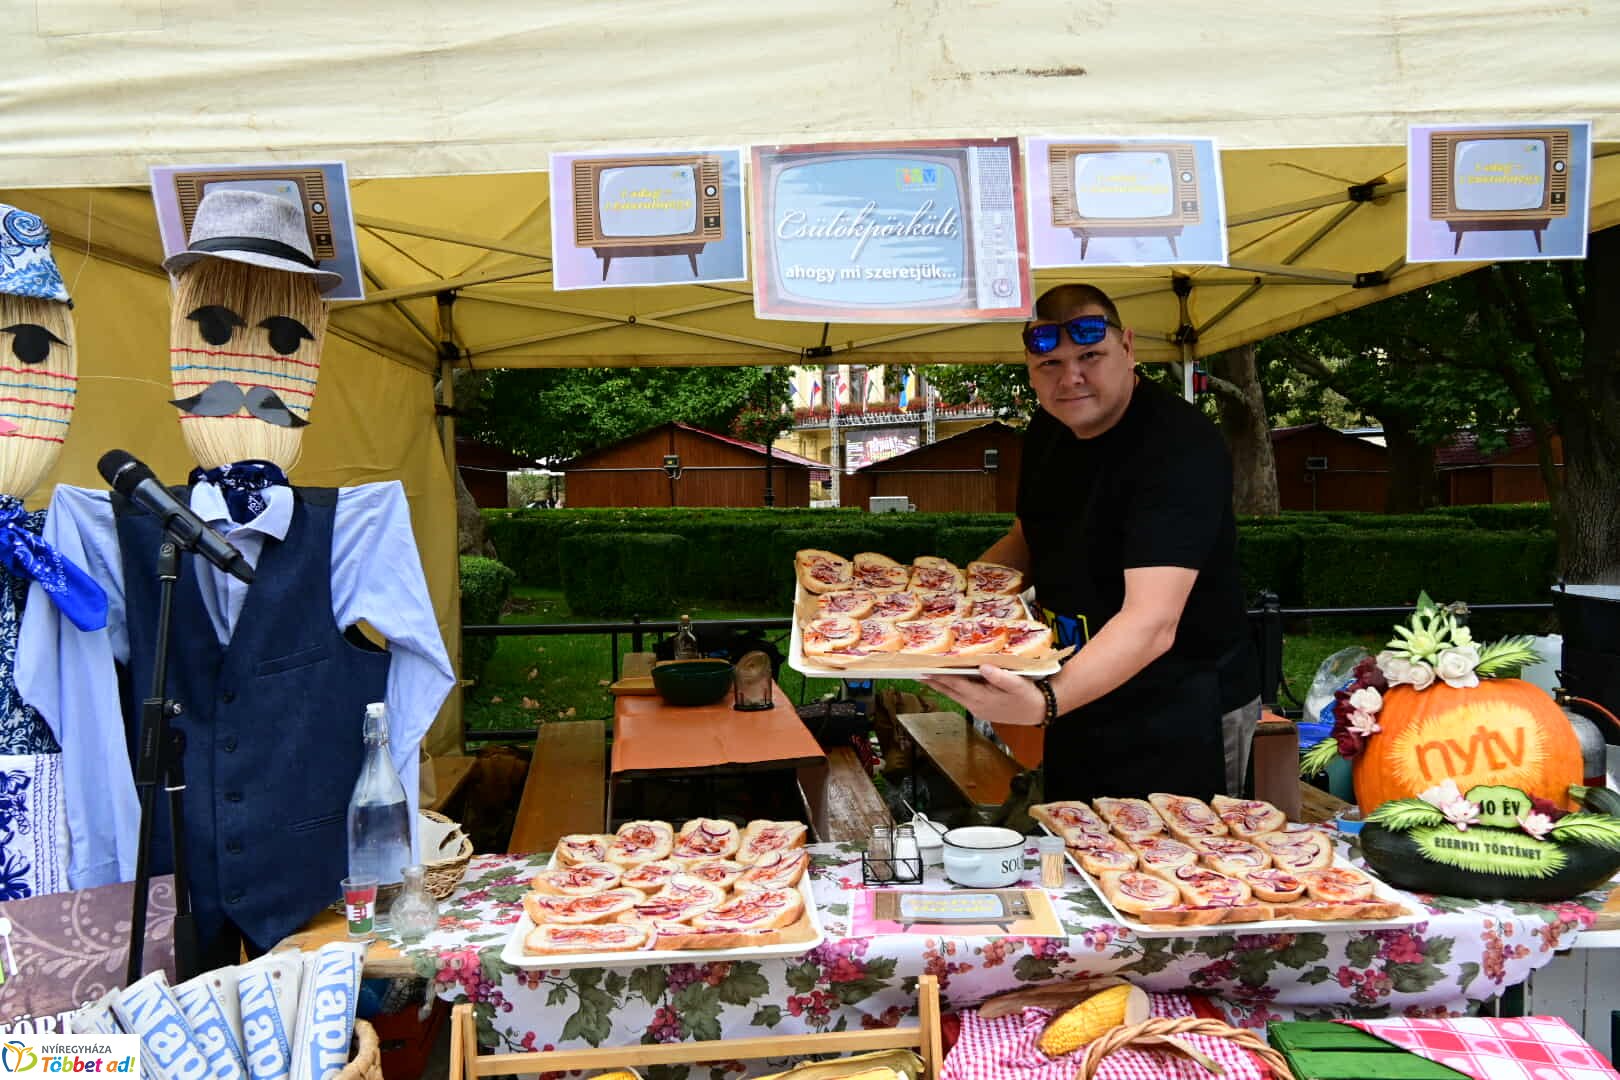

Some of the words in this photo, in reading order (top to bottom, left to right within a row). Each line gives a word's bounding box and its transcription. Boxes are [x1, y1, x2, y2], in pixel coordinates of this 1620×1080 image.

[776, 200, 958, 261] Csülökpörkölt,
[785, 265, 835, 282] ahogy
[840, 265, 861, 279] mi
[865, 263, 957, 281] szeretjük...
[1415, 725, 1526, 781] nytv
[1503, 797, 1520, 815] ÉV
